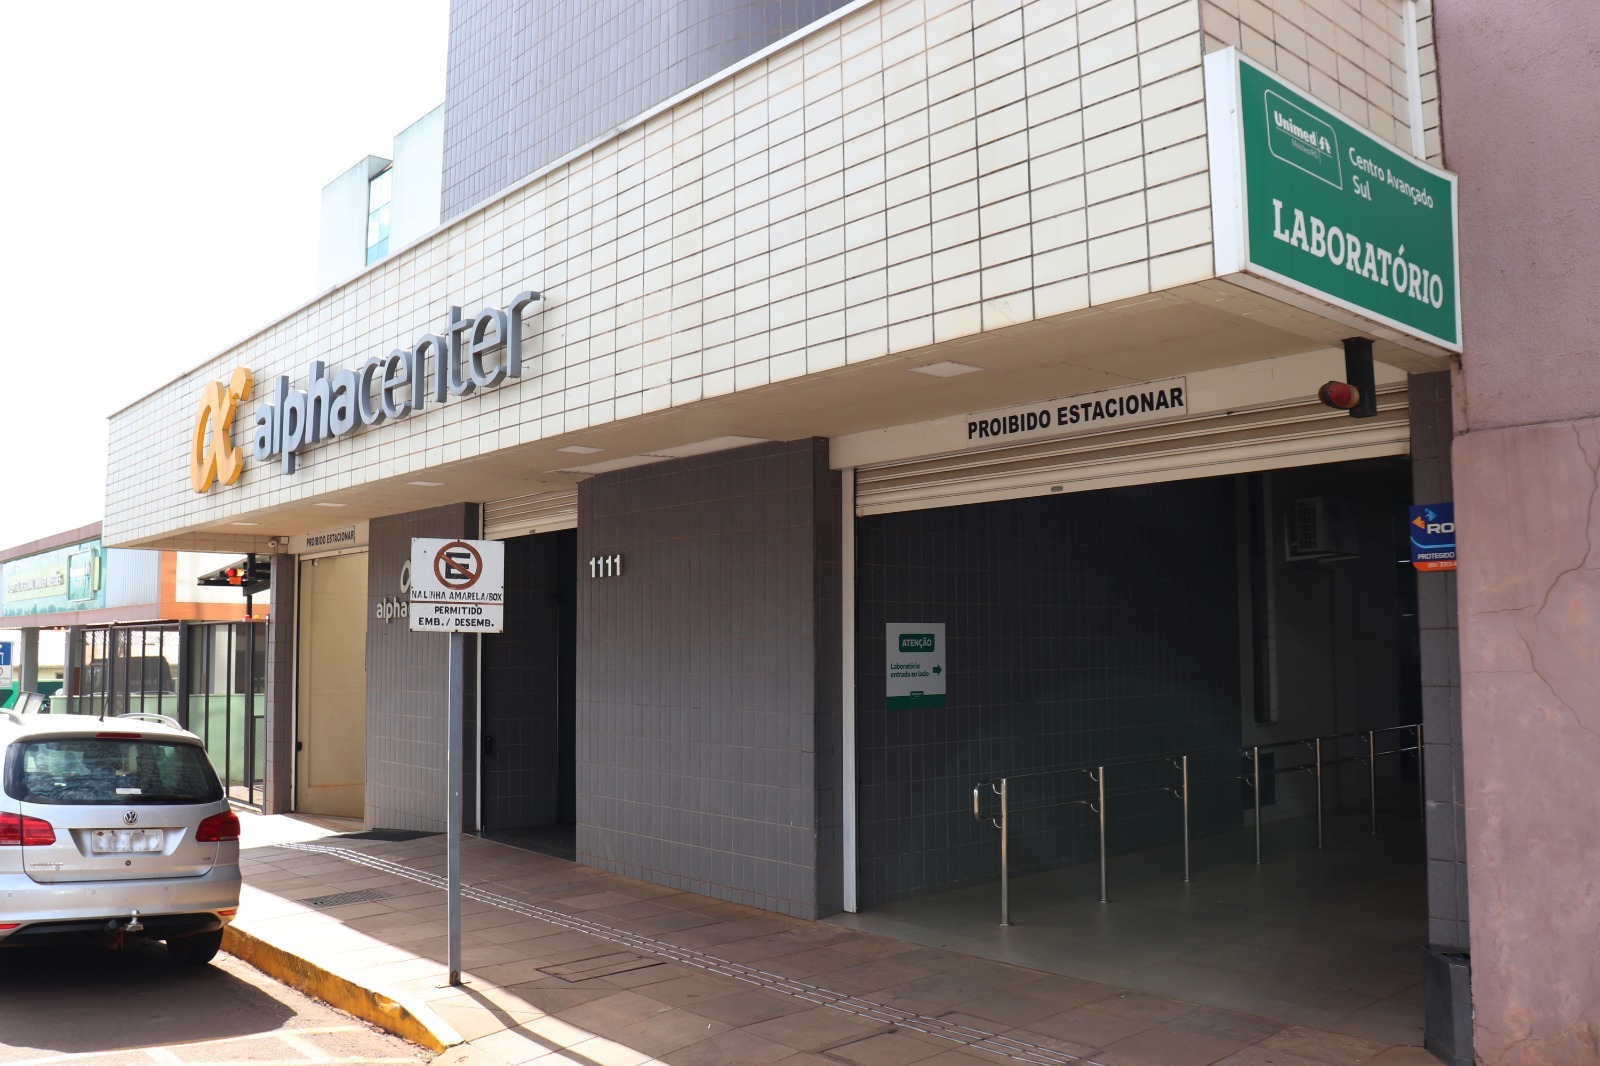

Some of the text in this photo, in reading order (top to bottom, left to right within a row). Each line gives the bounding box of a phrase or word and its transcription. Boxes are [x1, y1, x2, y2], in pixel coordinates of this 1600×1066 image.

[1273, 110, 1318, 146] Unimed
[1348, 147, 1434, 208] Centro Avançado
[1352, 175, 1372, 201] Sul
[1272, 198, 1444, 309] LABORATÓRIO
[253, 290, 541, 475] alphacenter
[967, 387, 1184, 440] PROIBIDO ESTACIONAR
[306, 530, 354, 548] PROIBIDO ESTACIONAR
[1417, 551, 1455, 560] PROTEGIDO
[589, 554, 621, 578] 1111
[411, 590, 503, 601] NA LINHA AMARELA/BOX
[434, 605, 483, 615] PERMITIDO
[454, 617, 495, 627] DESEMB.
[902, 636, 932, 649] ATENÇÃO
[890, 661, 920, 670] Laboratório
[890, 670, 911, 678] entrada
